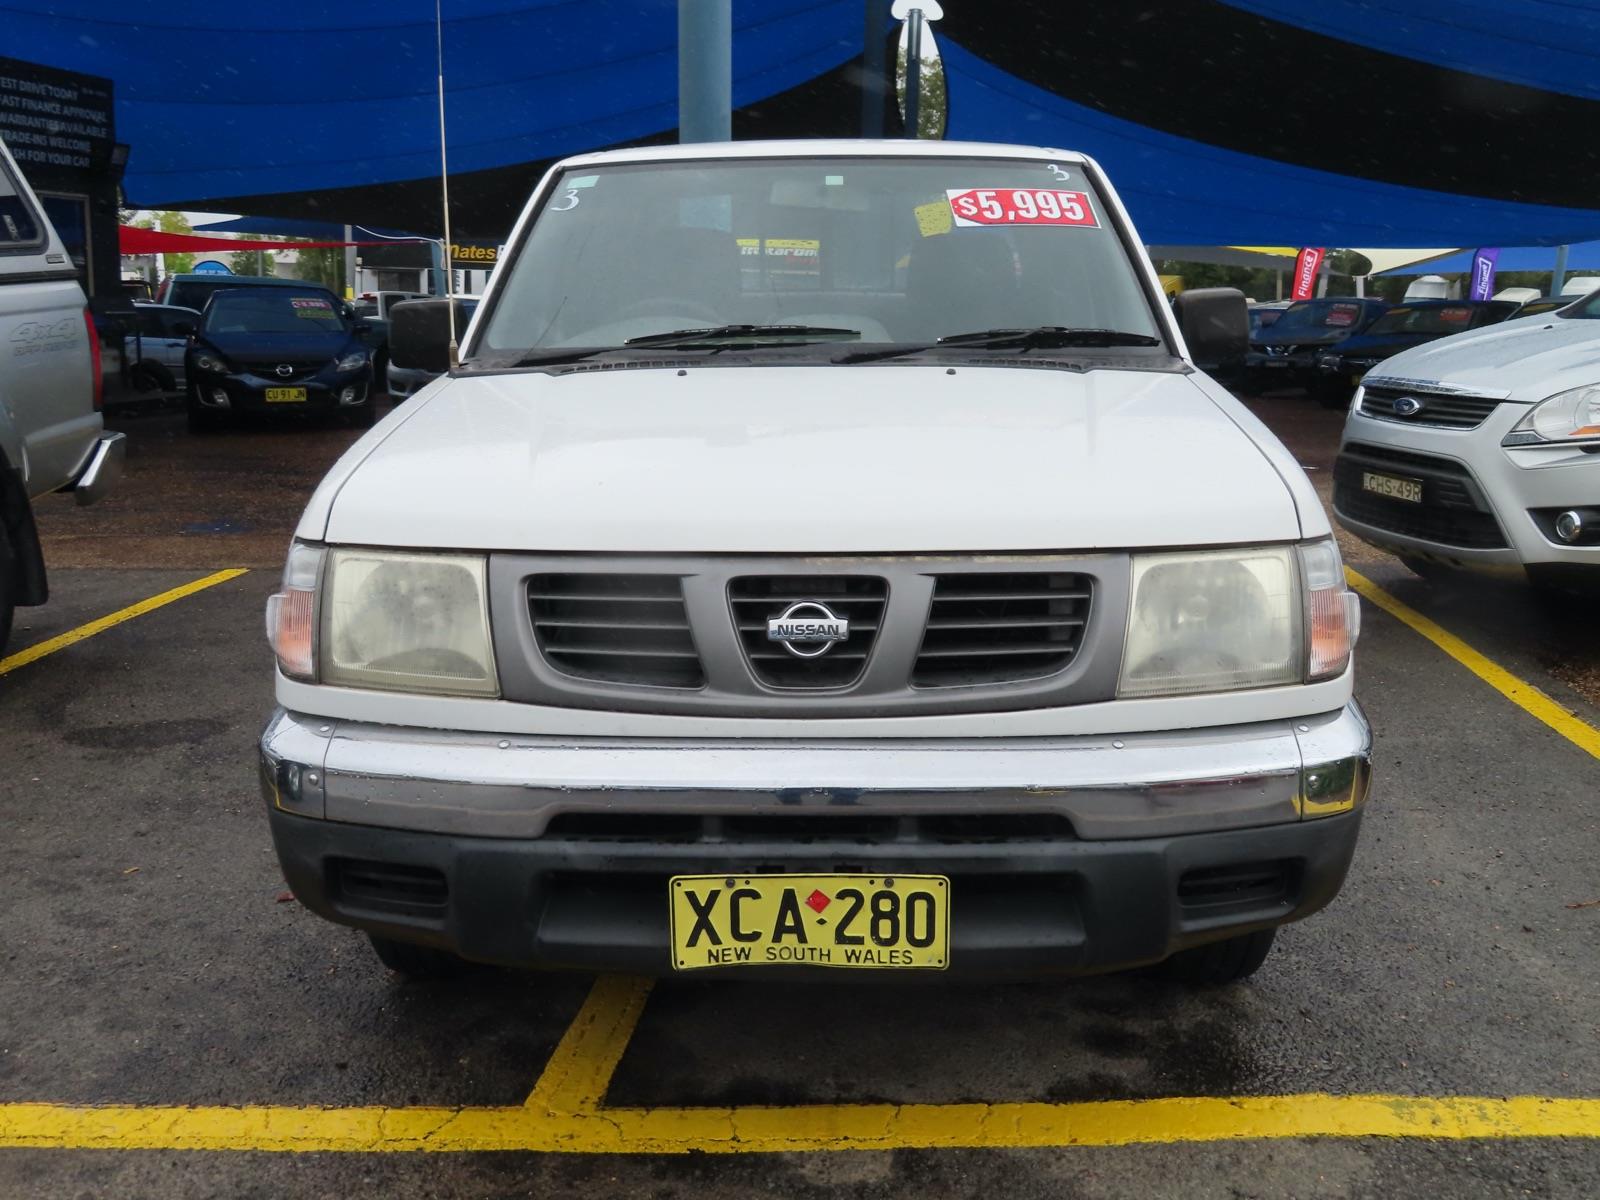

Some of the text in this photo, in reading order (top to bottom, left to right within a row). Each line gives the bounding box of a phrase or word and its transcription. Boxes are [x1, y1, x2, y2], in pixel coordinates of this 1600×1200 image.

[20, 81, 48, 95] DRIVE
[48, 86, 78, 101] TODAY
[23, 98, 61, 114] FINANCE
[63, 105, 107, 123] APPROVAL
[60, 121, 107, 139] AVAILABLE
[49, 136, 91, 154] WELCOME
[28, 150, 47, 163] FOR
[48, 153, 72, 167] YOUR
[73, 156, 90, 168] CAR
[1046, 164, 1071, 181] 3
[551, 189, 580, 211] 3
[958, 190, 1085, 221] $5,995
[1298, 255, 1314, 297] Finance
[777, 625, 839, 636] NISSAN
[834, 889, 936, 947] 280
[707, 946, 914, 964] NEW SOUTH WALES
